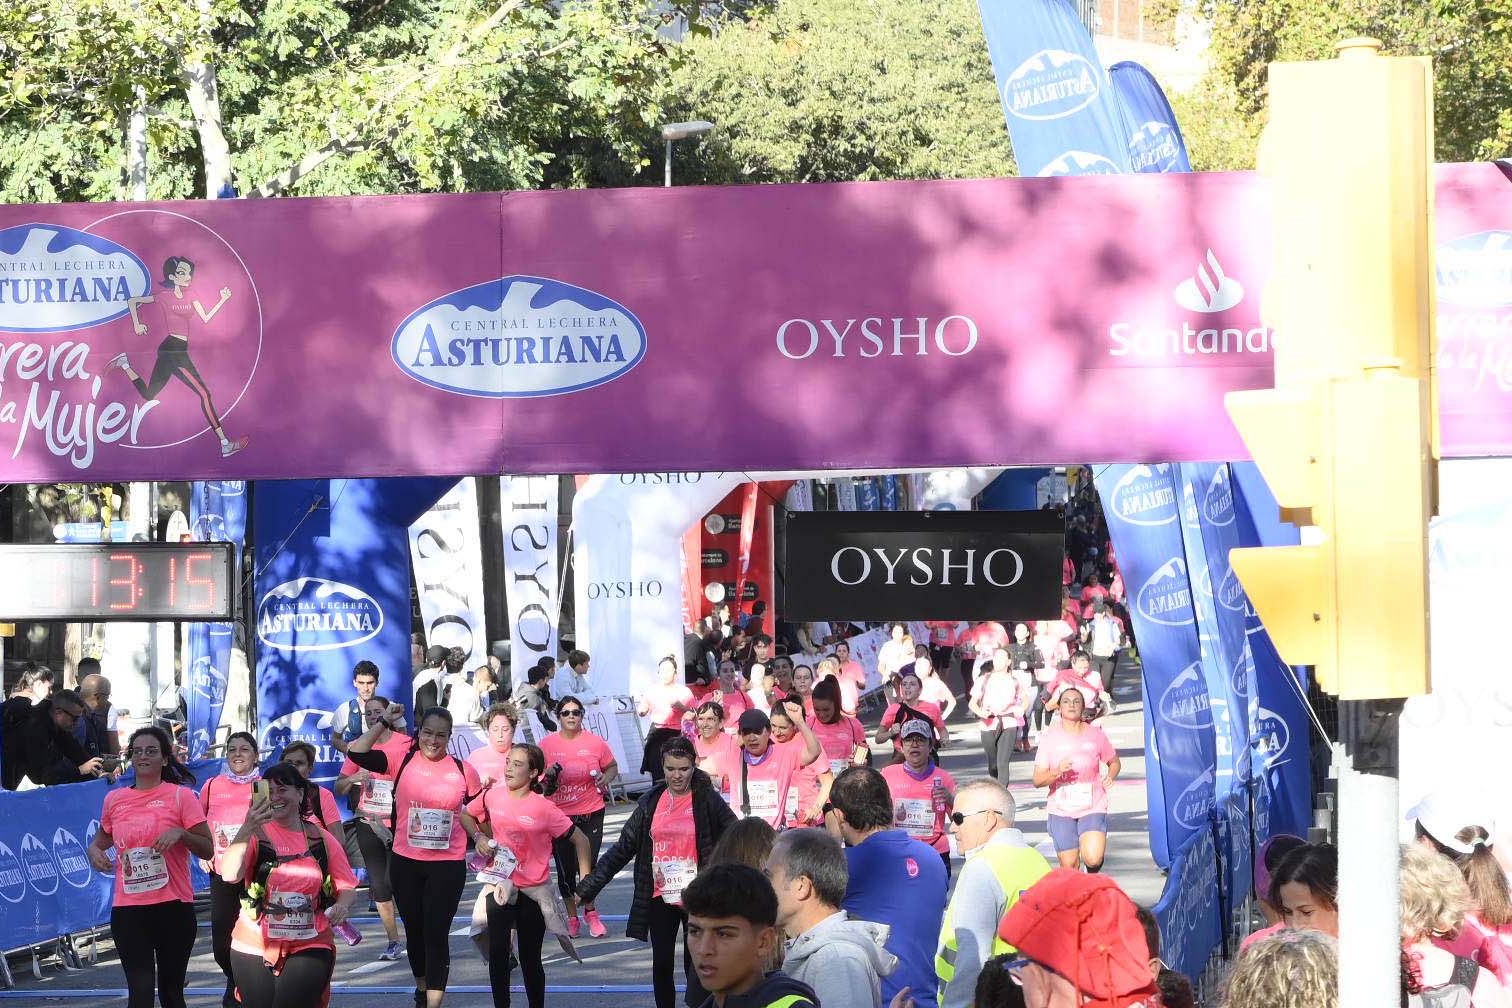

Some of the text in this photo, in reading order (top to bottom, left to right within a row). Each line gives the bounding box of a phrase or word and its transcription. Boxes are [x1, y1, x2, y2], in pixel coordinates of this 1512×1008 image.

[54, 260, 127, 271] LECHERA
[450, 316, 619, 332] CENTRAL LECHERA
[775, 315, 979, 360] OYSHO
[411, 323, 627, 368] ASTURIANA
[12, 375, 161, 469] Mujer
[830, 546, 1024, 587] OYSHO
[587, 579, 663, 600] OYSHO
[260, 607, 375, 635] ASTURIANA
[273, 603, 316, 611] CENTRAL
